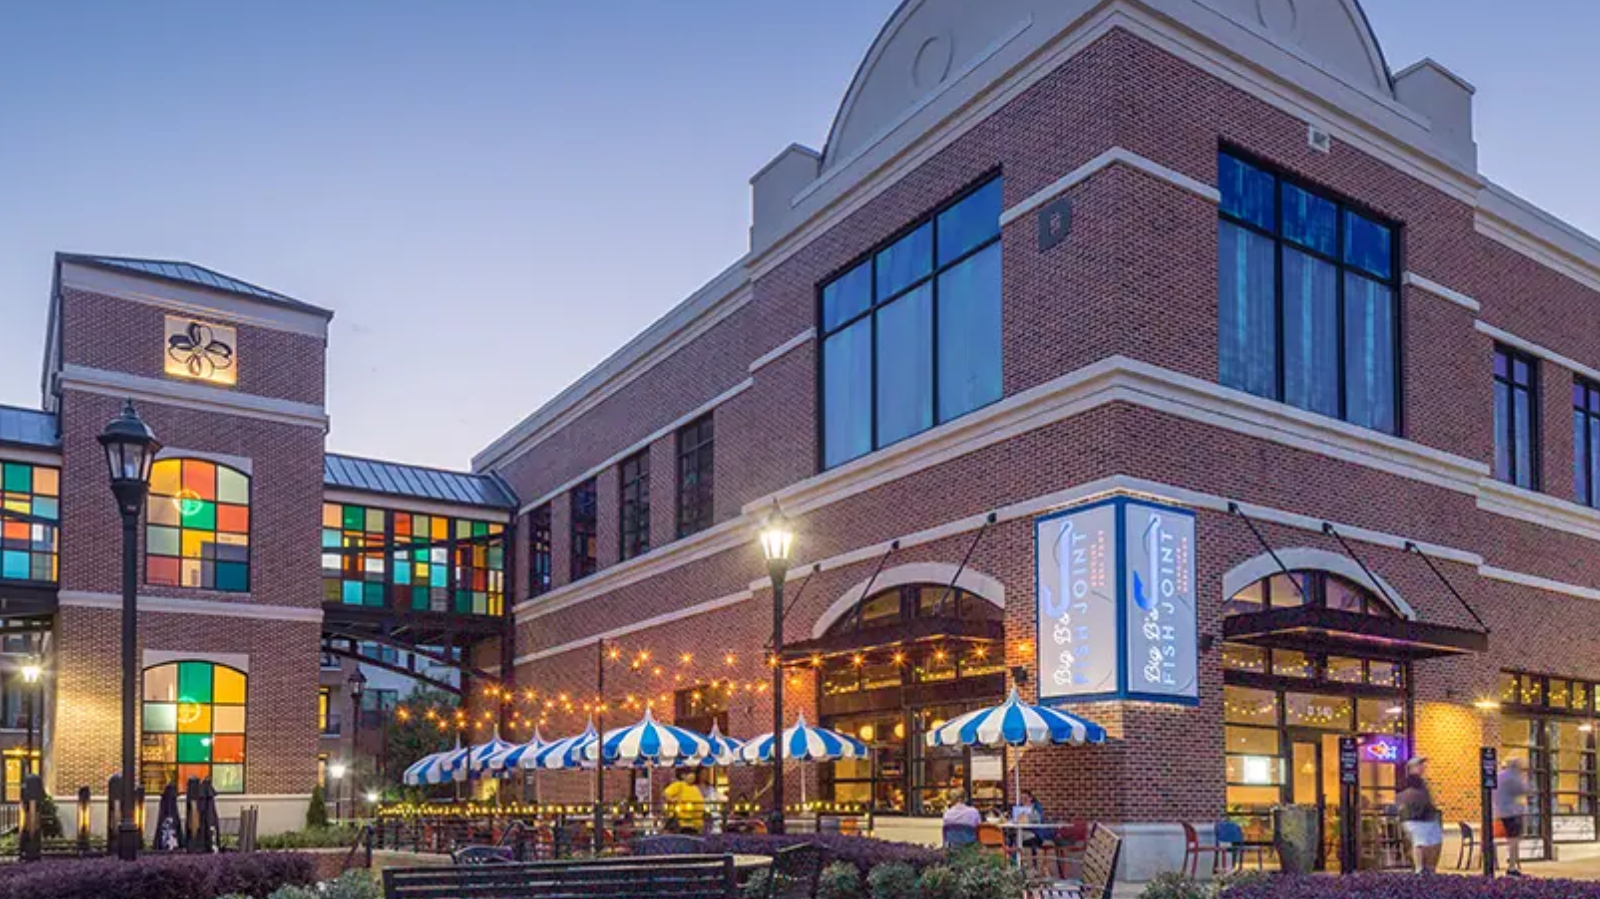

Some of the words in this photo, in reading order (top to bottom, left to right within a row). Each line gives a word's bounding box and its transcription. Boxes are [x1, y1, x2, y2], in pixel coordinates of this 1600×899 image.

[1038, 199, 1071, 252] D
[1072, 531, 1088, 614] JOINT
[1160, 530, 1175, 614] JOINT
[1053, 612, 1072, 645] B's
[1144, 607, 1161, 641] B's
[1053, 650, 1075, 686] Big
[1073, 626, 1090, 685] FISH
[1144, 647, 1163, 683] Big
[1161, 626, 1177, 686] FISH
